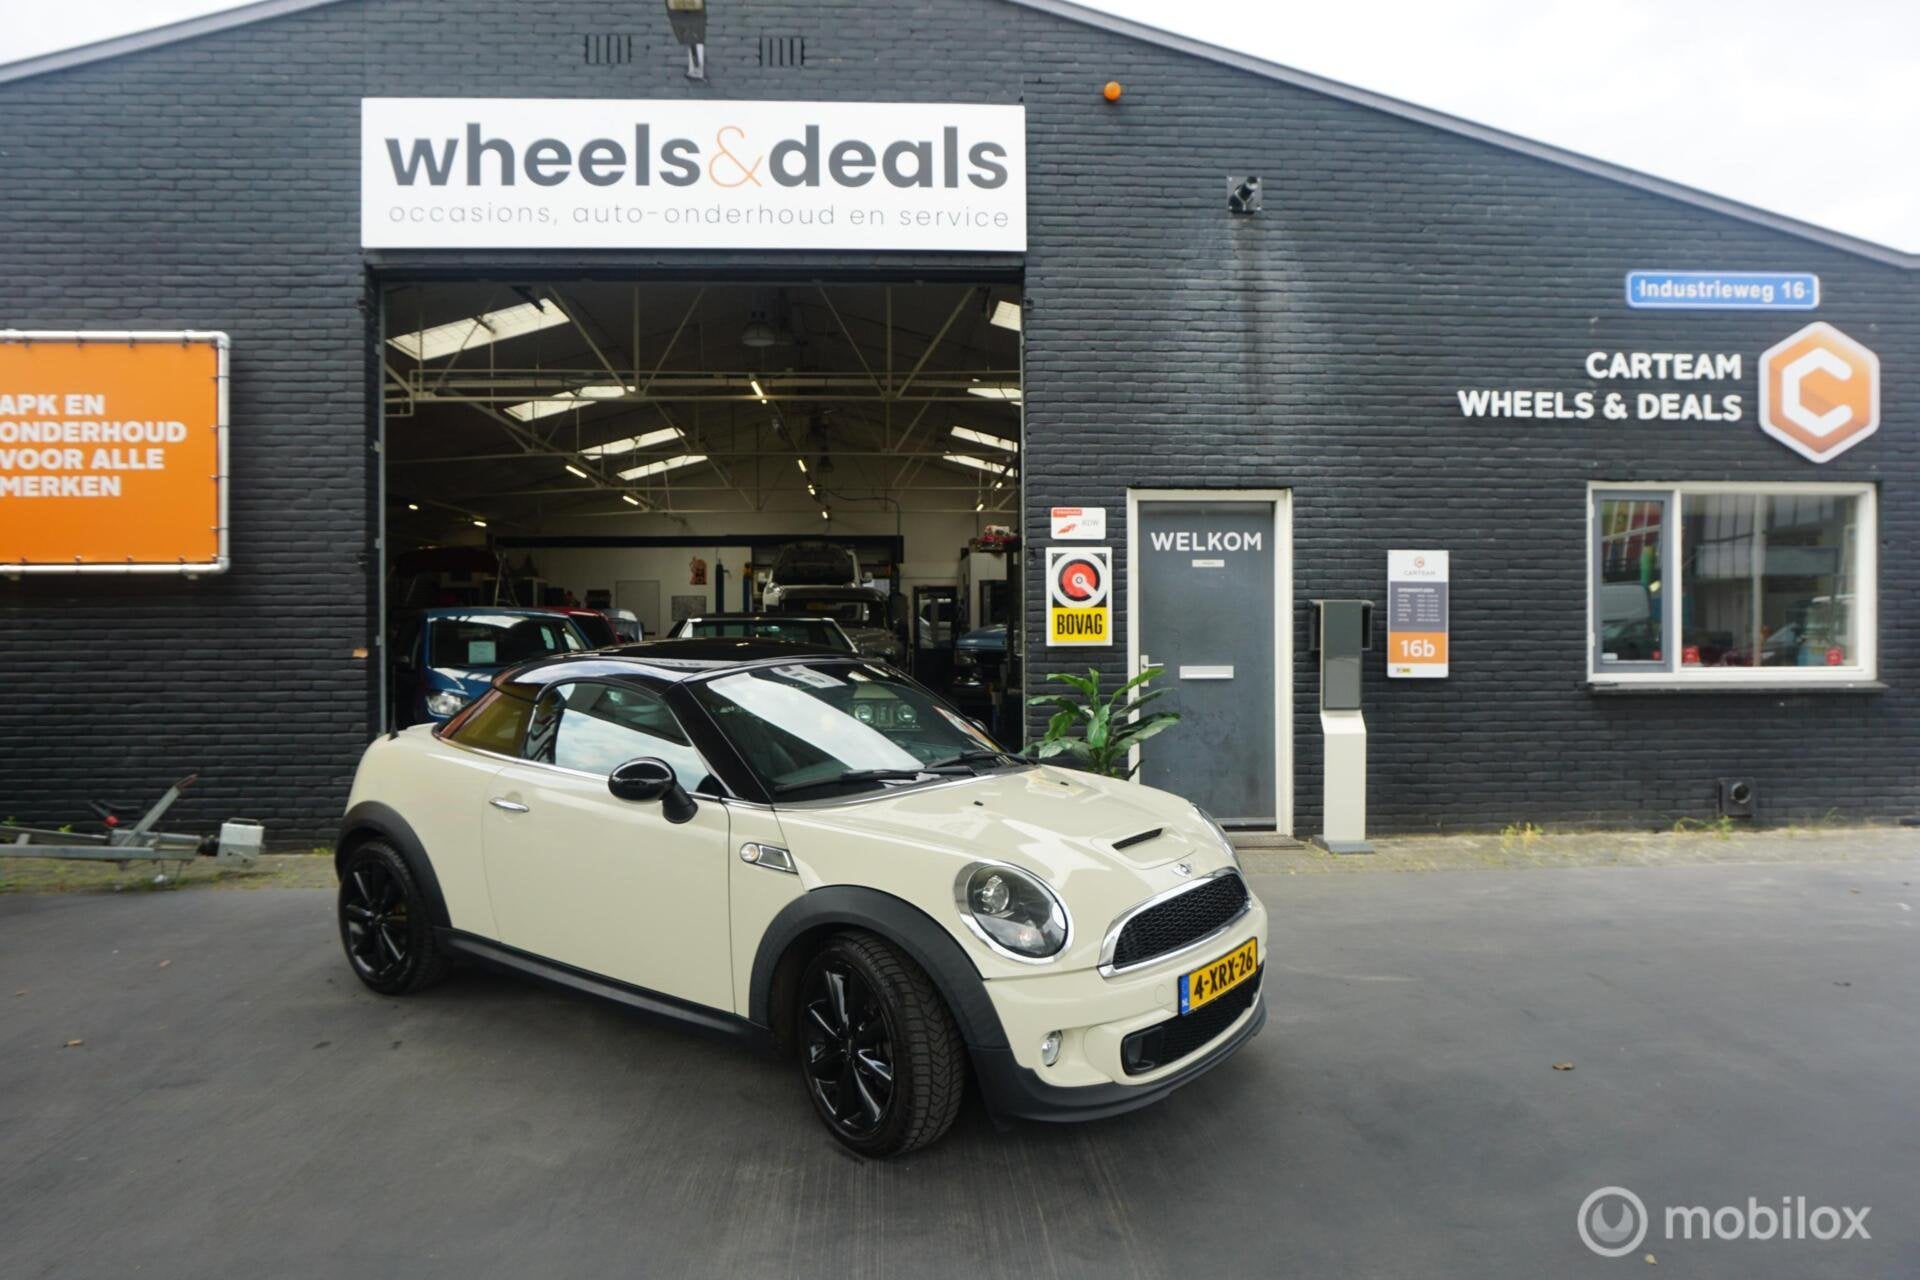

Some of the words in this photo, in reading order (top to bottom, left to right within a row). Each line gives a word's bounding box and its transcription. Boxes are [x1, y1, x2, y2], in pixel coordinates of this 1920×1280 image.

[388, 201, 558, 226] occasions,
[572, 203, 836, 226] auto-onderhoud
[849, 209, 885, 226] en
[898, 206, 1010, 228] service
[1639, 279, 1774, 303] Industrieweg
[1782, 281, 1806, 300] 16
[1585, 351, 1742, 380] CARTEAM
[0, 394, 58, 416] APK
[64, 394, 105, 416] EN
[1457, 390, 1594, 418] WHEELS
[1603, 392, 1628, 420] &
[1637, 393, 1743, 421] DEALS
[0, 421, 187, 443] ONDERHOUD
[0, 448, 84, 470] VOOR
[90, 448, 164, 470] ALLE
[0, 475, 121, 497] MERKEN
[1150, 531, 1263, 552] WELKOM
[1056, 613, 1103, 635] BOVAG
[1400, 639, 1436, 658] 16b
[1193, 946, 1254, 1001] 4-XRX-26
